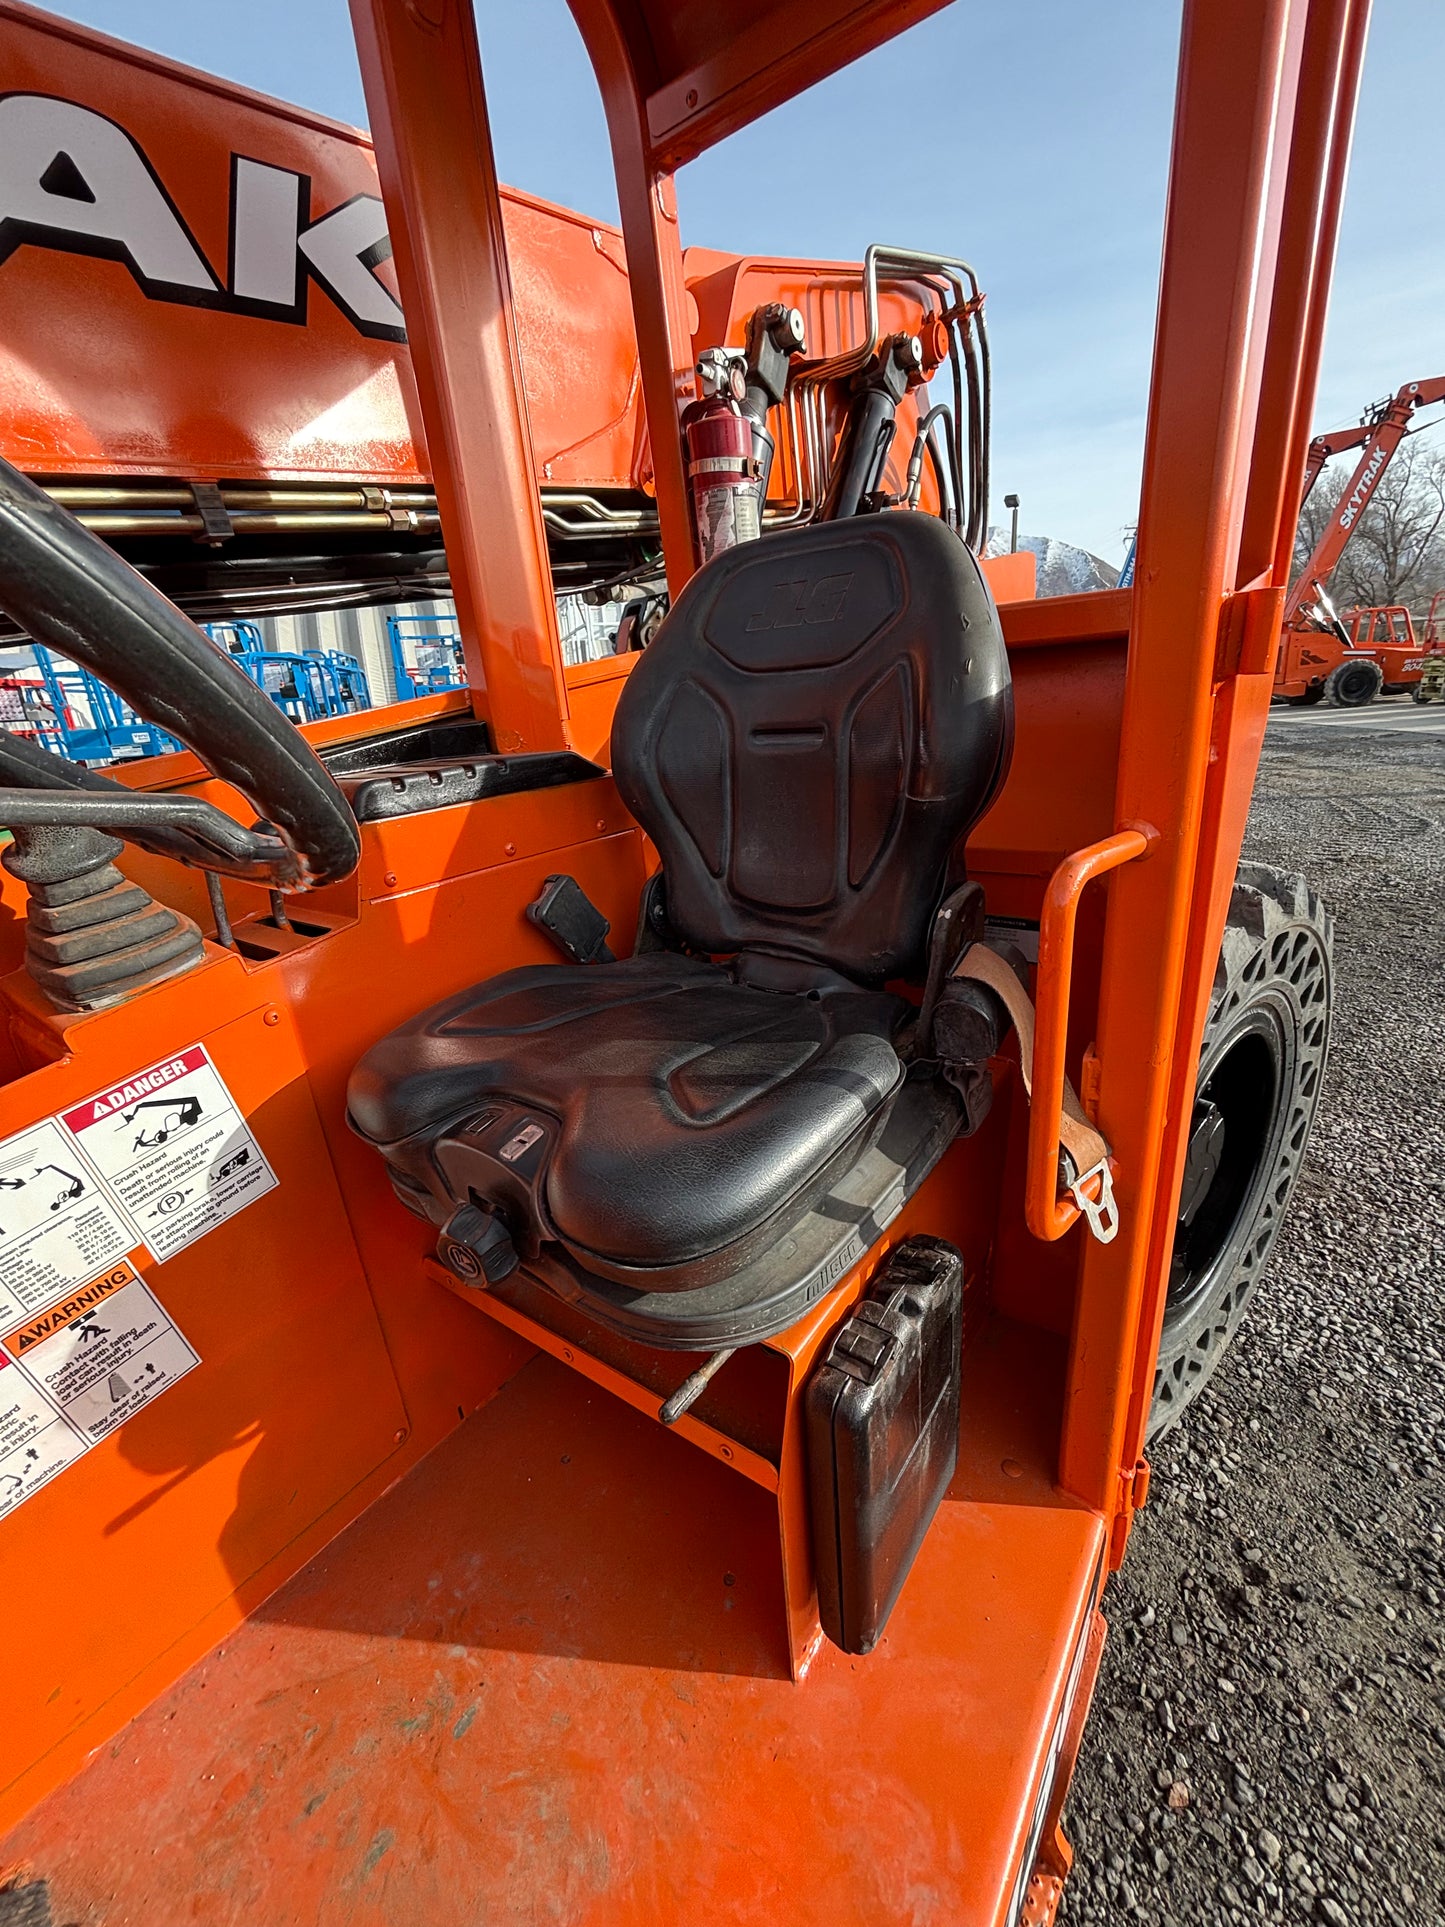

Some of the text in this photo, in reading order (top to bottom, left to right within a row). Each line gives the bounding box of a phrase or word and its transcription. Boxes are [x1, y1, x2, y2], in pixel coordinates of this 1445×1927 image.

[1340, 445, 1387, 529] SKYTRAK
[107, 1059, 188, 1109] DANGER
[114, 1152, 167, 1186] Crush Hazard
[120, 1130, 224, 1195] Death or serious injury could
[124, 1148, 210, 1201] result from rolling of an
[129, 1159, 206, 1207] unattended machine.
[74, 1205, 100, 1222] Required
[75, 1211, 103, 1229] Clearance
[151, 1230, 165, 1241] Set
[166, 1212, 193, 1233] parking
[193, 1196, 217, 1212] brake,
[216, 1184, 236, 1198] lower
[236, 1165, 264, 1185] carriage
[155, 1238, 165, 1246] or
[165, 1210, 207, 1240] attachment
[215, 1189, 240, 1207] ground
[240, 1174, 261, 1190] before
[159, 1233, 187, 1252] leaving
[187, 1211, 219, 1234] machine.
[806, 1239, 856, 1301] milsco
[28, 1270, 128, 1339] WARNING
[45, 1336, 108, 1383] Crush Hazard
[51, 1327, 138, 1390] Contact with falling
[55, 1321, 157, 1396] load can result in death
[61, 1348, 134, 1402] or serious injury.
[88, 1417, 108, 1433] Stay
[109, 1400, 130, 1417] clear
[131, 1390, 140, 1400] of
[141, 1371, 166, 1392] raised
[93, 1394, 150, 1438] boom or load.
[2, 1413, 39, 1443] result in
[10, 1425, 40, 1447] injury.
[14, 1488, 25, 1499] of
[26, 1458, 67, 1490] machine.
